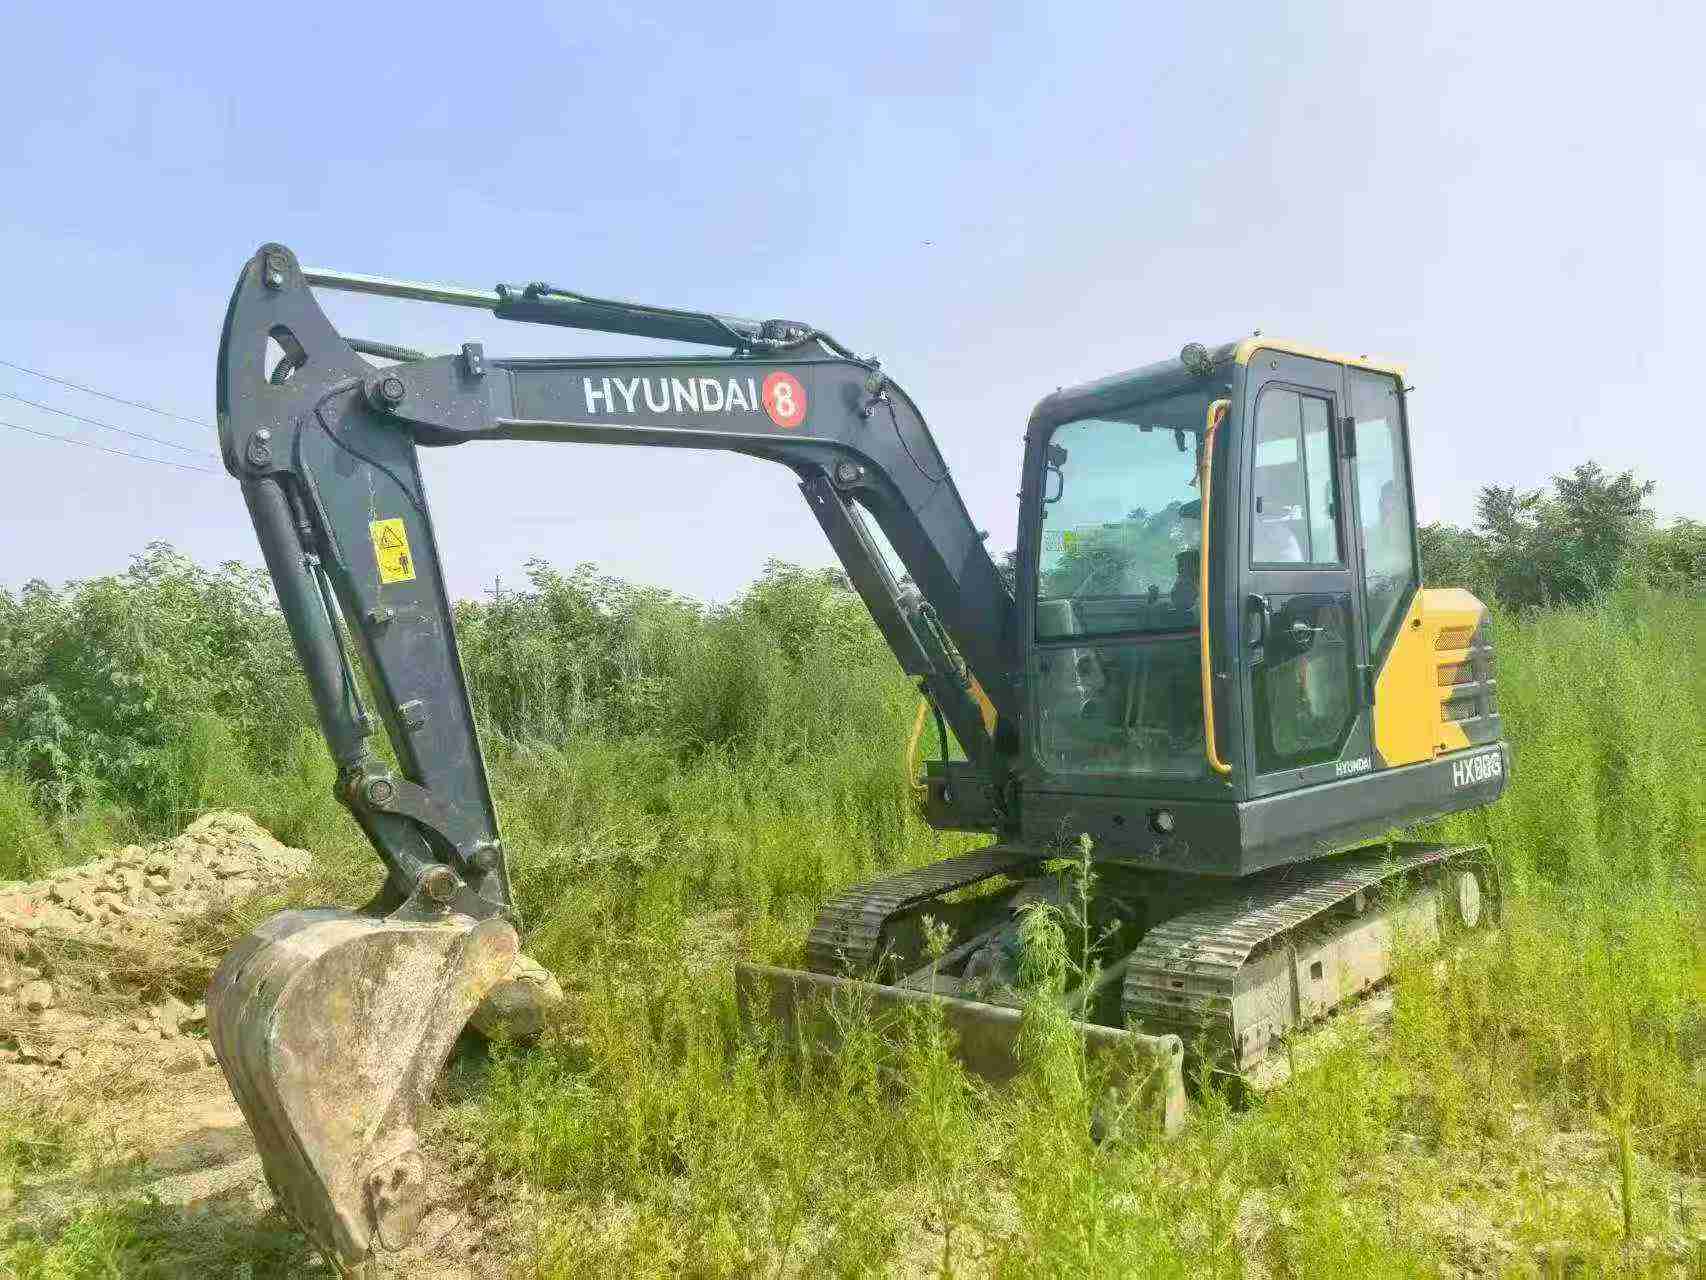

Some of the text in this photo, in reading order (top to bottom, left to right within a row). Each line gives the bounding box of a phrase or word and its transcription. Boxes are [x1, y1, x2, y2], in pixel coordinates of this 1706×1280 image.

[583, 376, 760, 414] HYUNDAI
[773, 381, 797, 417] 8
[1335, 756, 1372, 776] HYUNDAI
